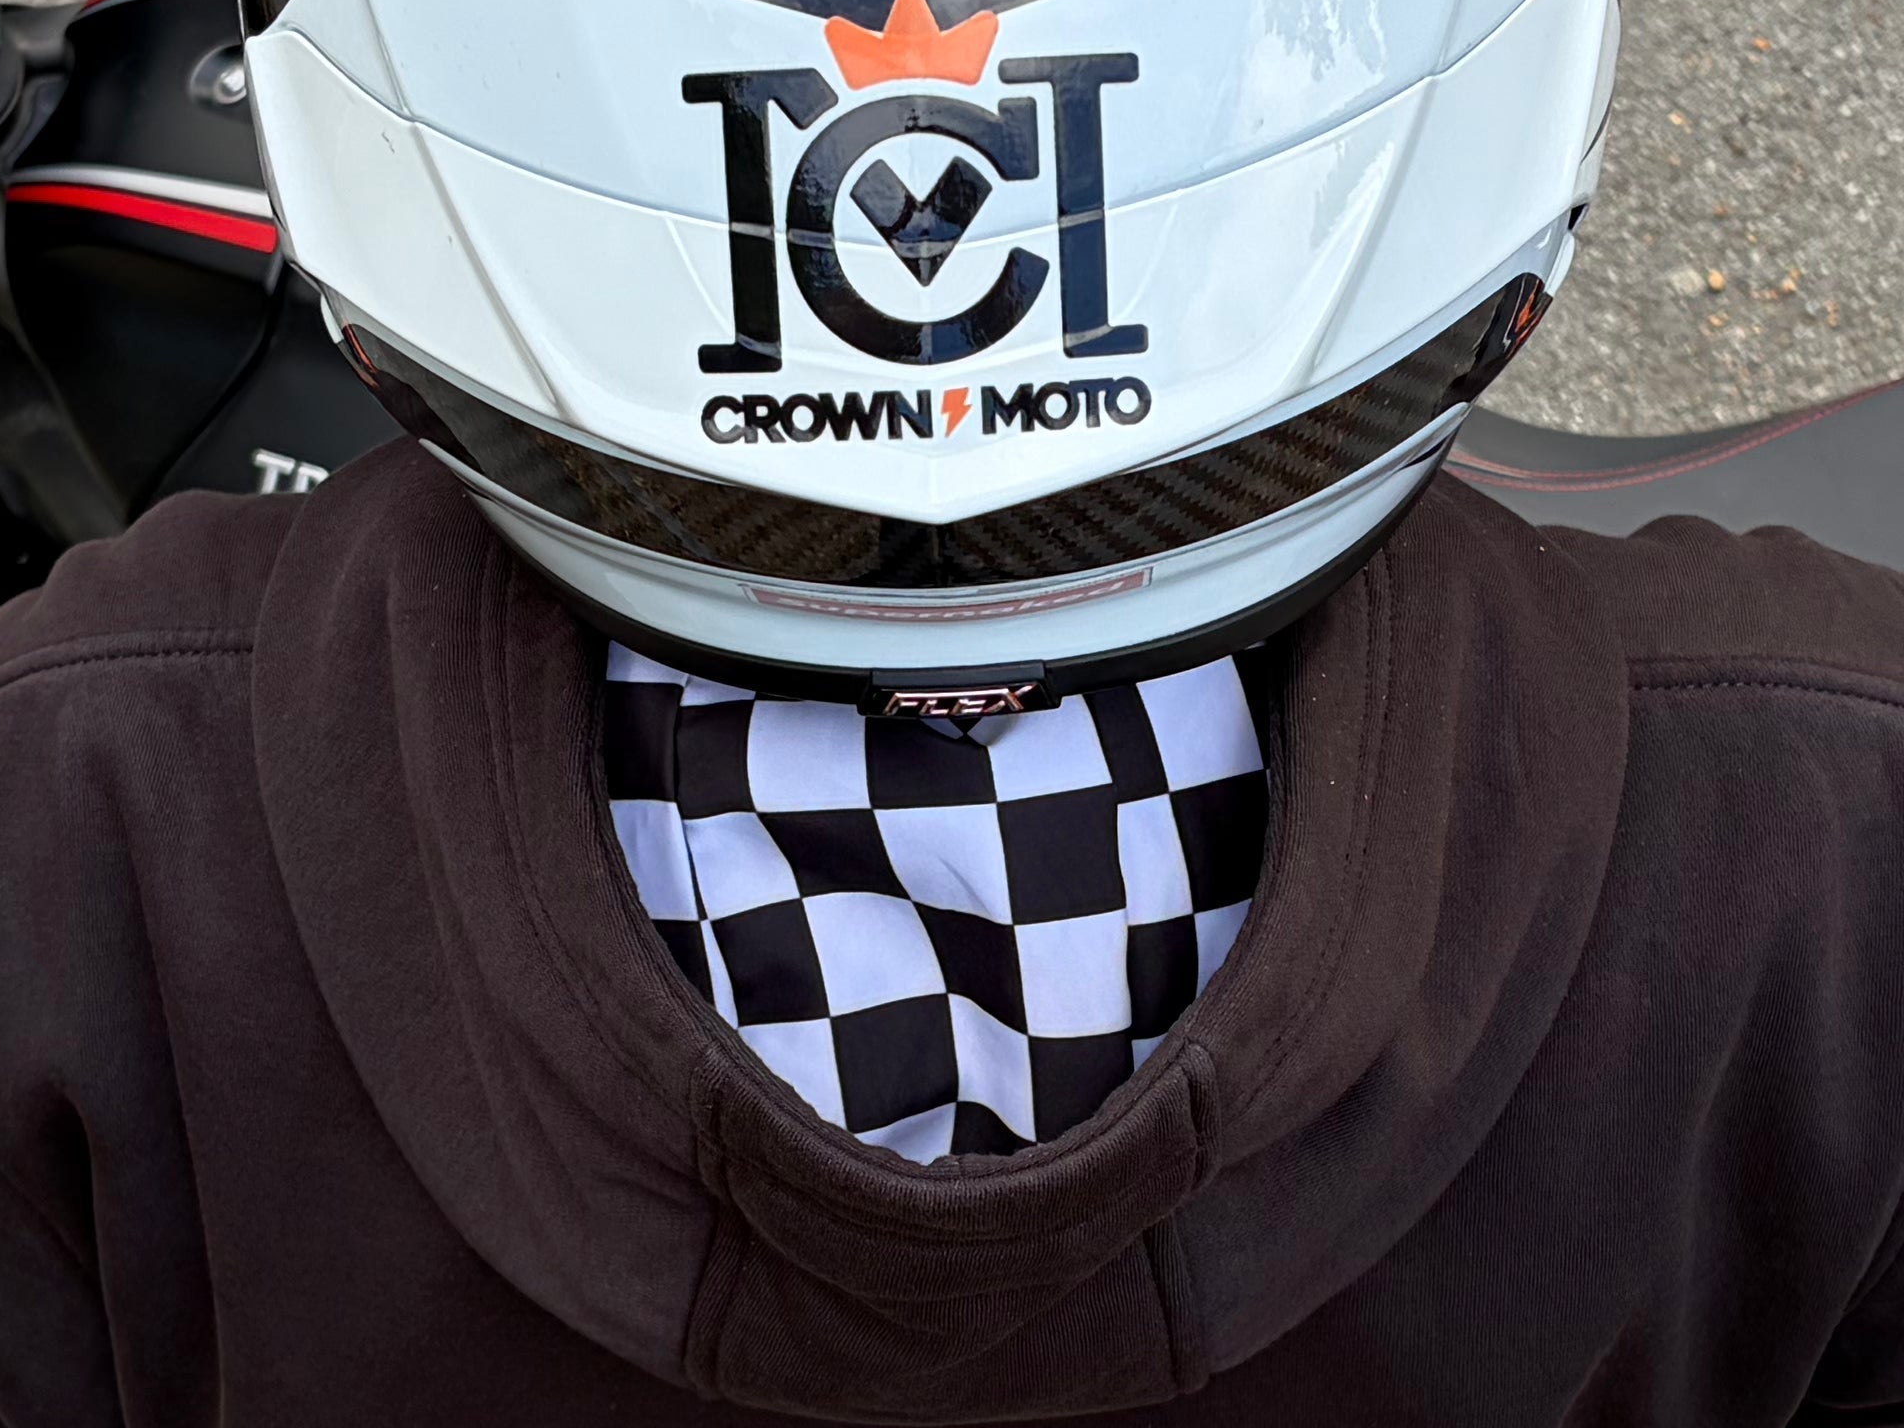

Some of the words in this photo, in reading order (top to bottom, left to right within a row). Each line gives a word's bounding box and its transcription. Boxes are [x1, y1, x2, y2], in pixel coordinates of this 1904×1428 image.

[700, 389, 935, 445] CROWN
[981, 375, 1153, 435] MOTO
[882, 682, 1036, 717] FLEX
